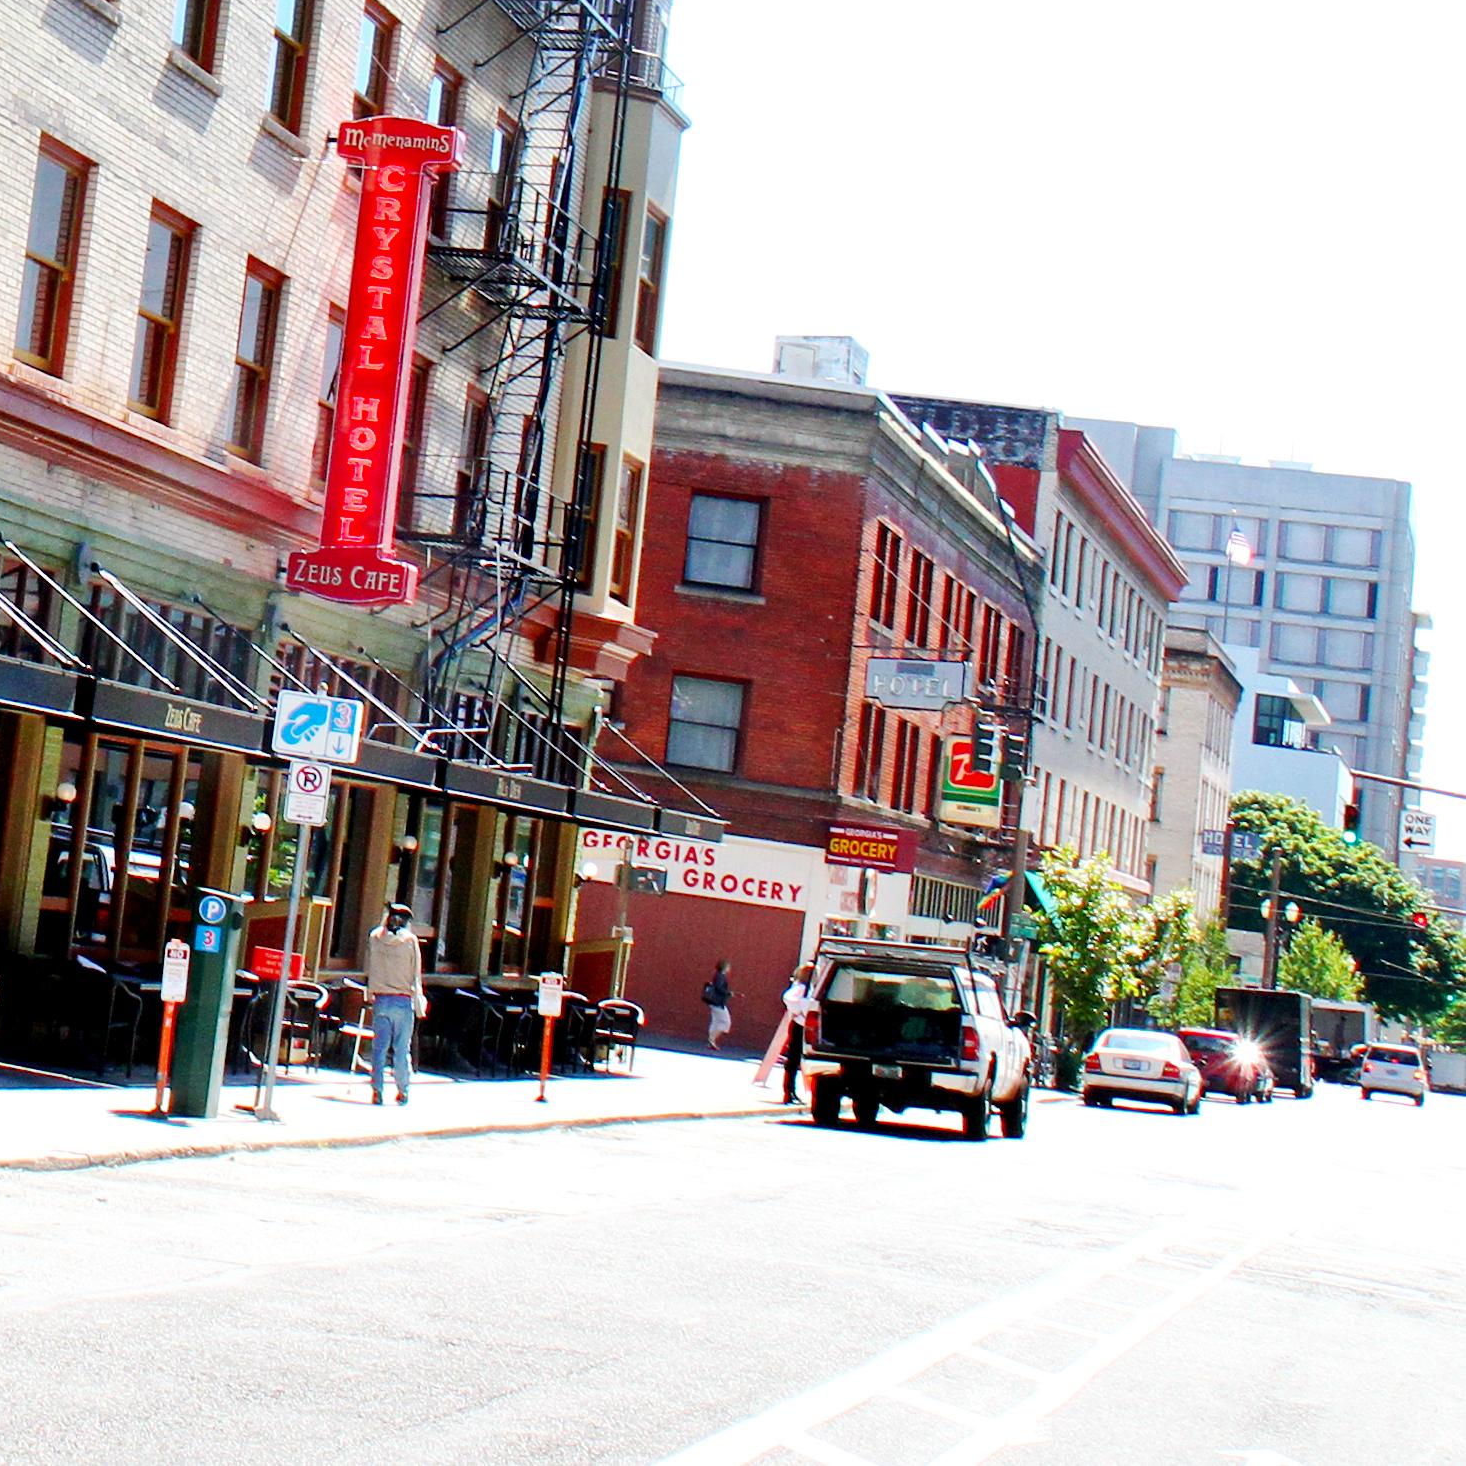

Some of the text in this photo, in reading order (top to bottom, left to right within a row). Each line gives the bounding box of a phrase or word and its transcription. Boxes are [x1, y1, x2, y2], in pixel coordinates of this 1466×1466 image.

[357, 165, 406, 371] CRYSTAL
[340, 396, 380, 542] HOTEL
[294, 559, 400, 593] ZEUS CAFE
[872, 674, 955, 700] HOTEL
[1403, 824, 1432, 836] WAY
[1404, 813, 1433, 826] ONE
[829, 837, 897, 860] GROCERY
[1203, 831, 1253, 850] HOEL
[682, 868, 803, 904] GROCERY
